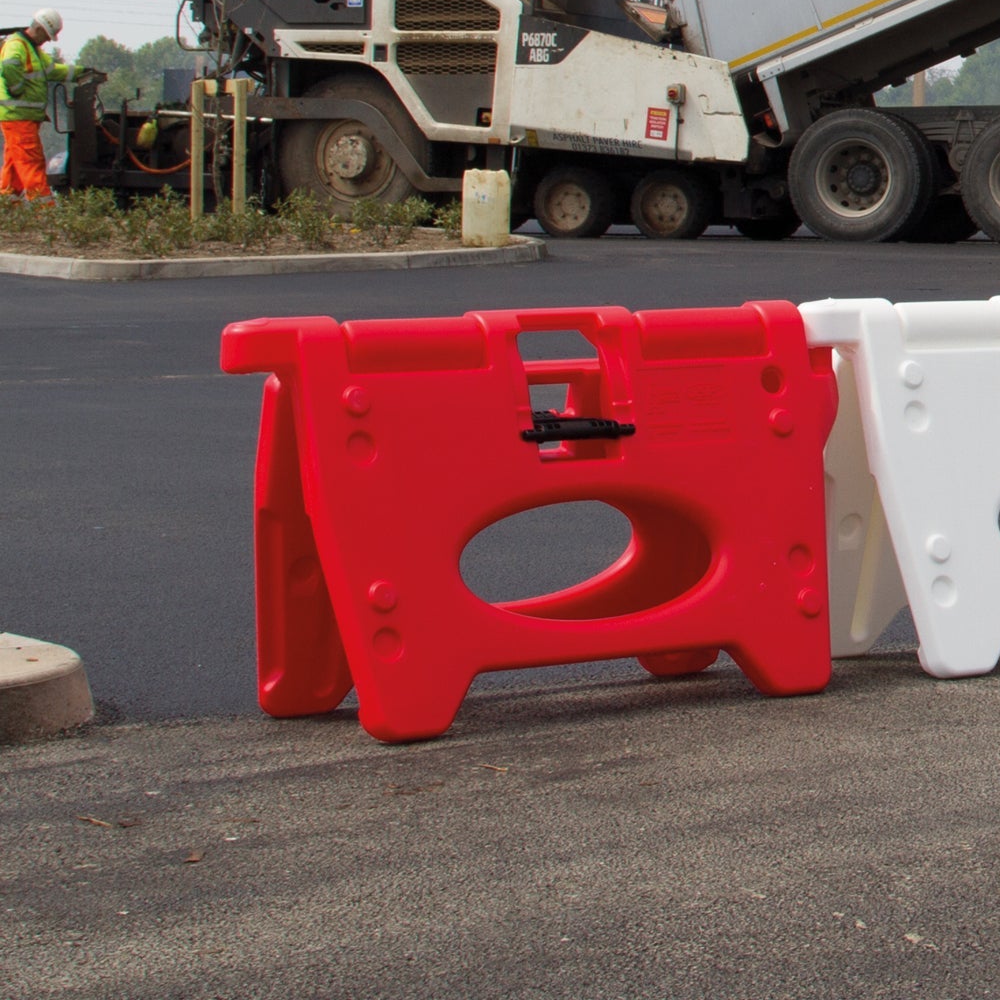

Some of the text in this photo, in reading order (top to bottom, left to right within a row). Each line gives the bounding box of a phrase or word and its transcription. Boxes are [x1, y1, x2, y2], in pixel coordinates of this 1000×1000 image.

[521, 32, 557, 47] P6870C
[529, 48, 549, 63] ABG
[552, 132, 643, 150] ASPHALT PAVER HIRE
